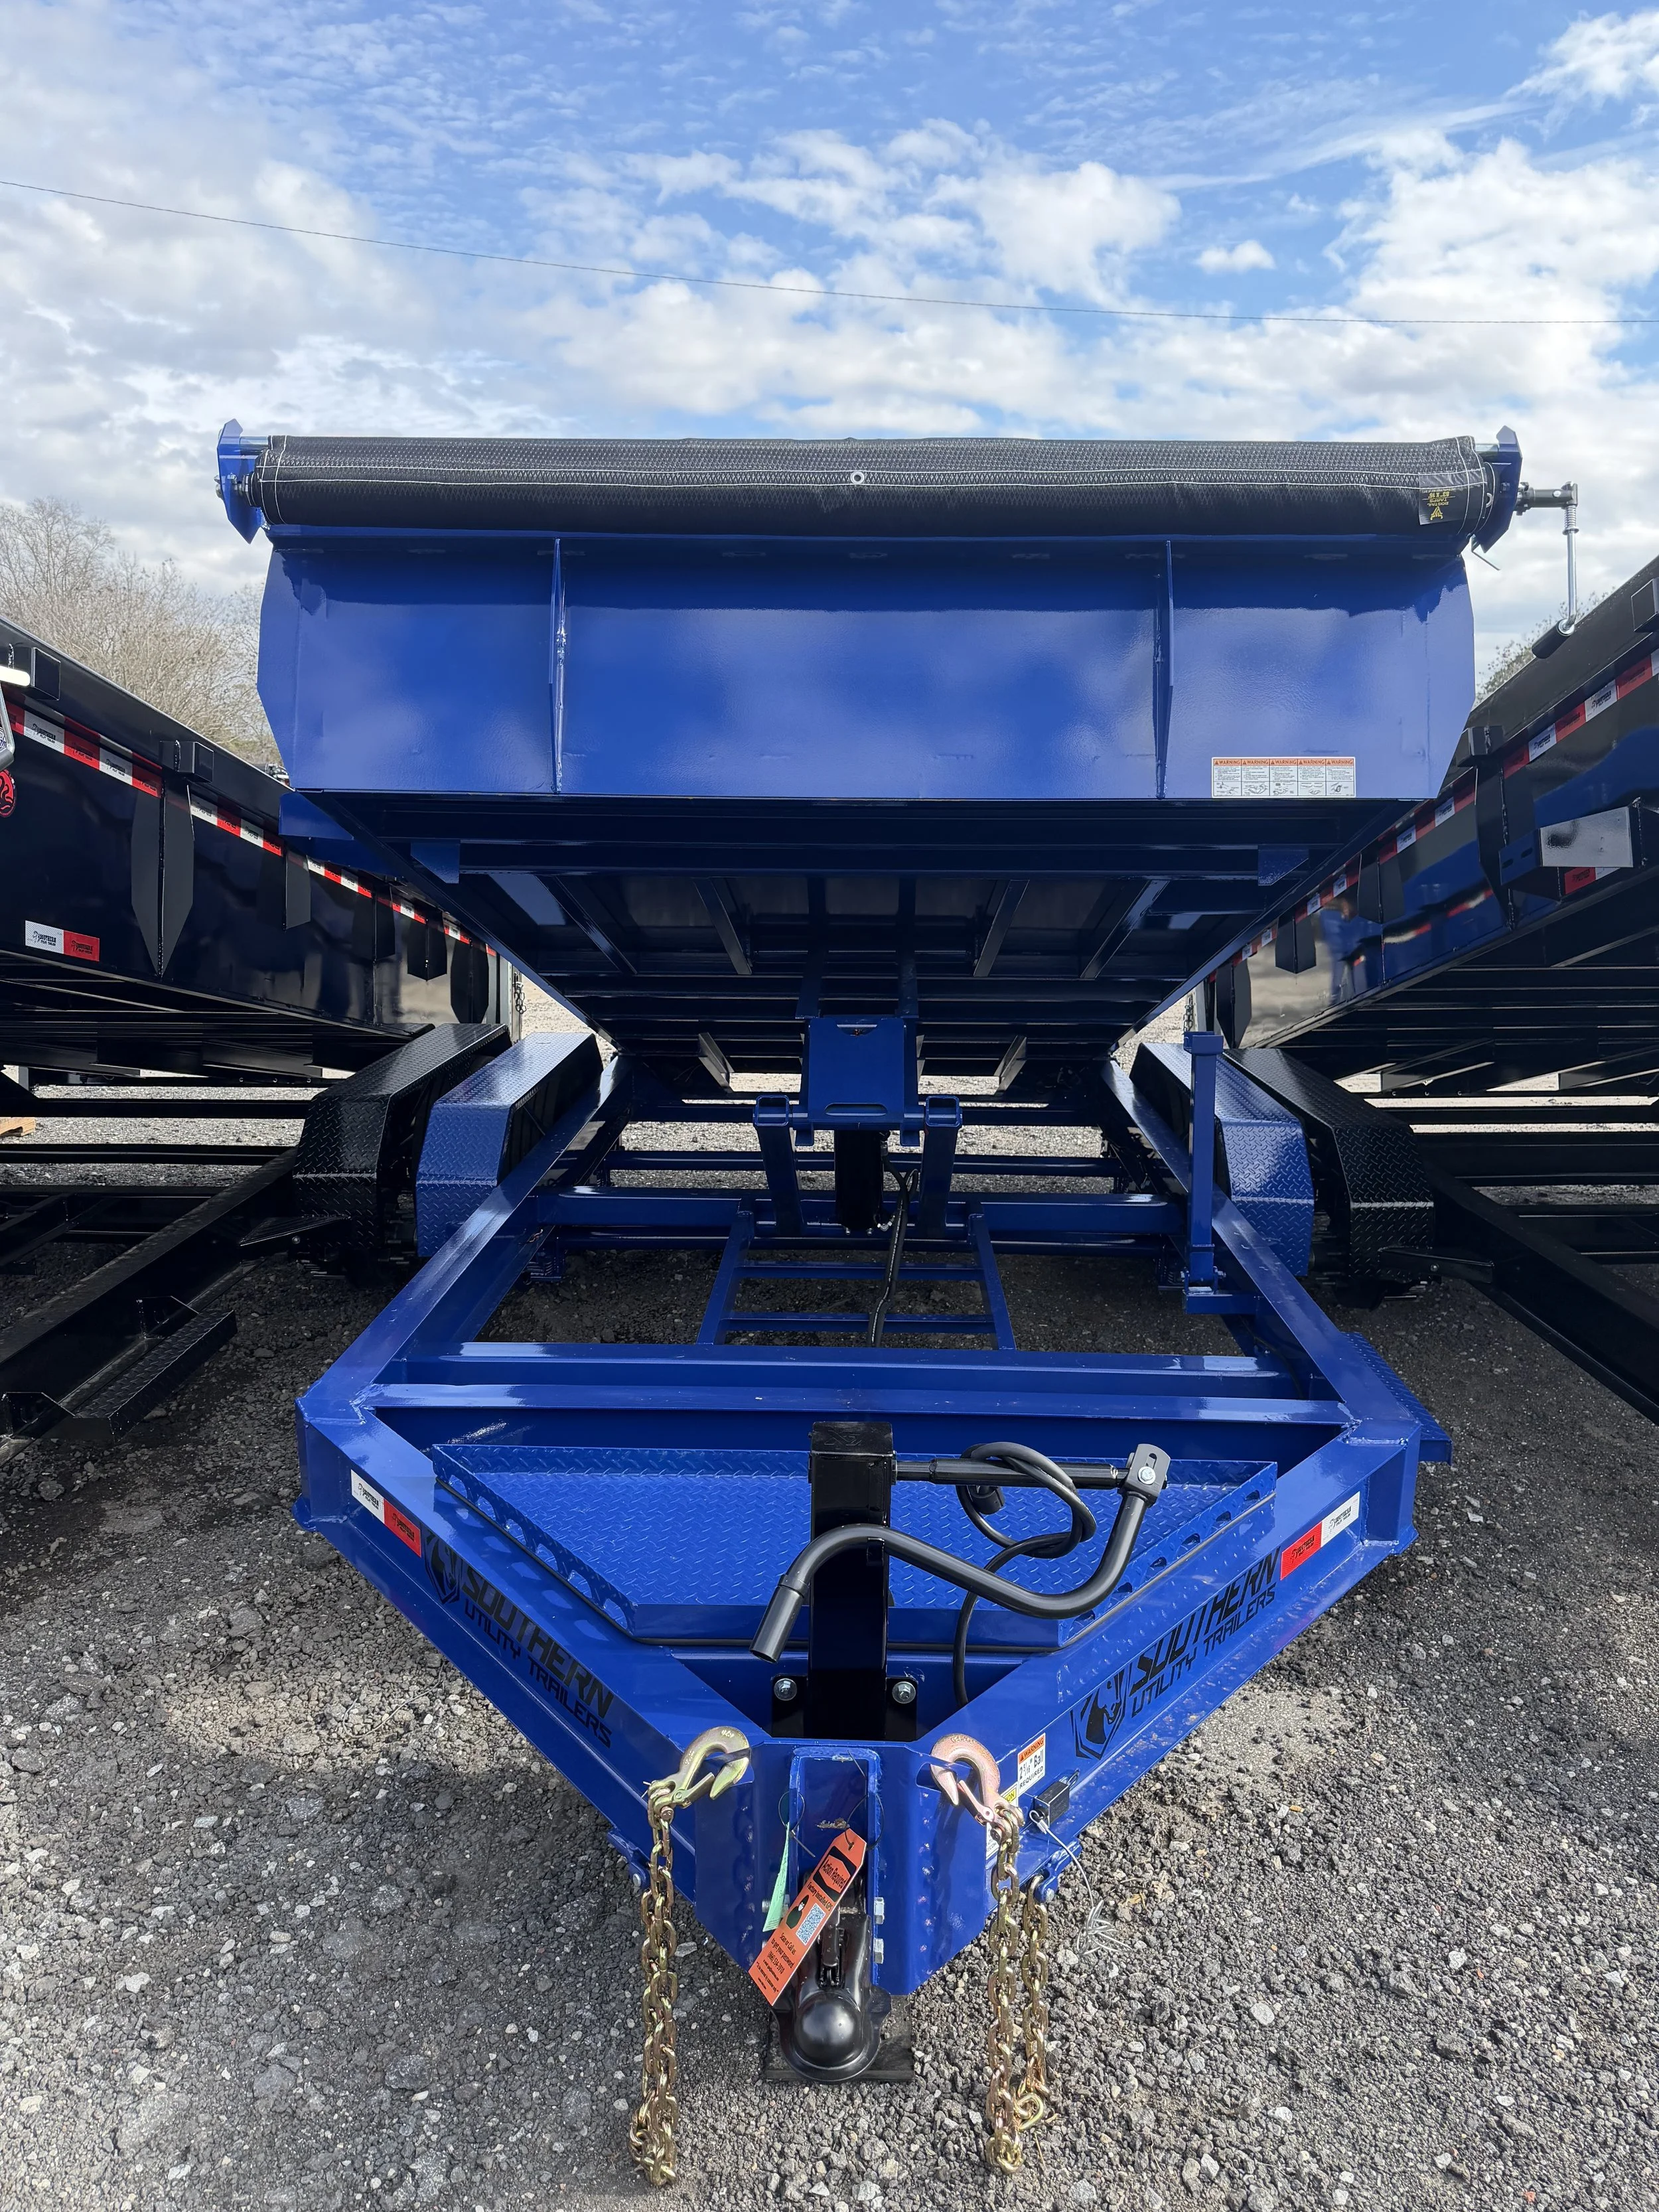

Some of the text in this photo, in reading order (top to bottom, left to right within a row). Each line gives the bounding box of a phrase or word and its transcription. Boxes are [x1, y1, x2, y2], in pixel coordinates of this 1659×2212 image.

[1129, 1546, 1281, 1697] SOUTHERN
[462, 1566, 614, 1718] SOUTHERN
[1131, 1582, 1277, 1718] UTILITY TRAILERS
[465, 1598, 612, 1749] UTILITY TRAILERS
[1024, 1737, 1044, 1757] WARNING
[1019, 1766, 1023, 1780] 2
[1034, 1749, 1044, 1768] Ball
[1019, 1765, 1043, 1789] REQUIRED
[807, 1881, 817, 1897] Factory
[821, 1859, 848, 1889] Action Required
[780, 1953, 795, 1968] password
